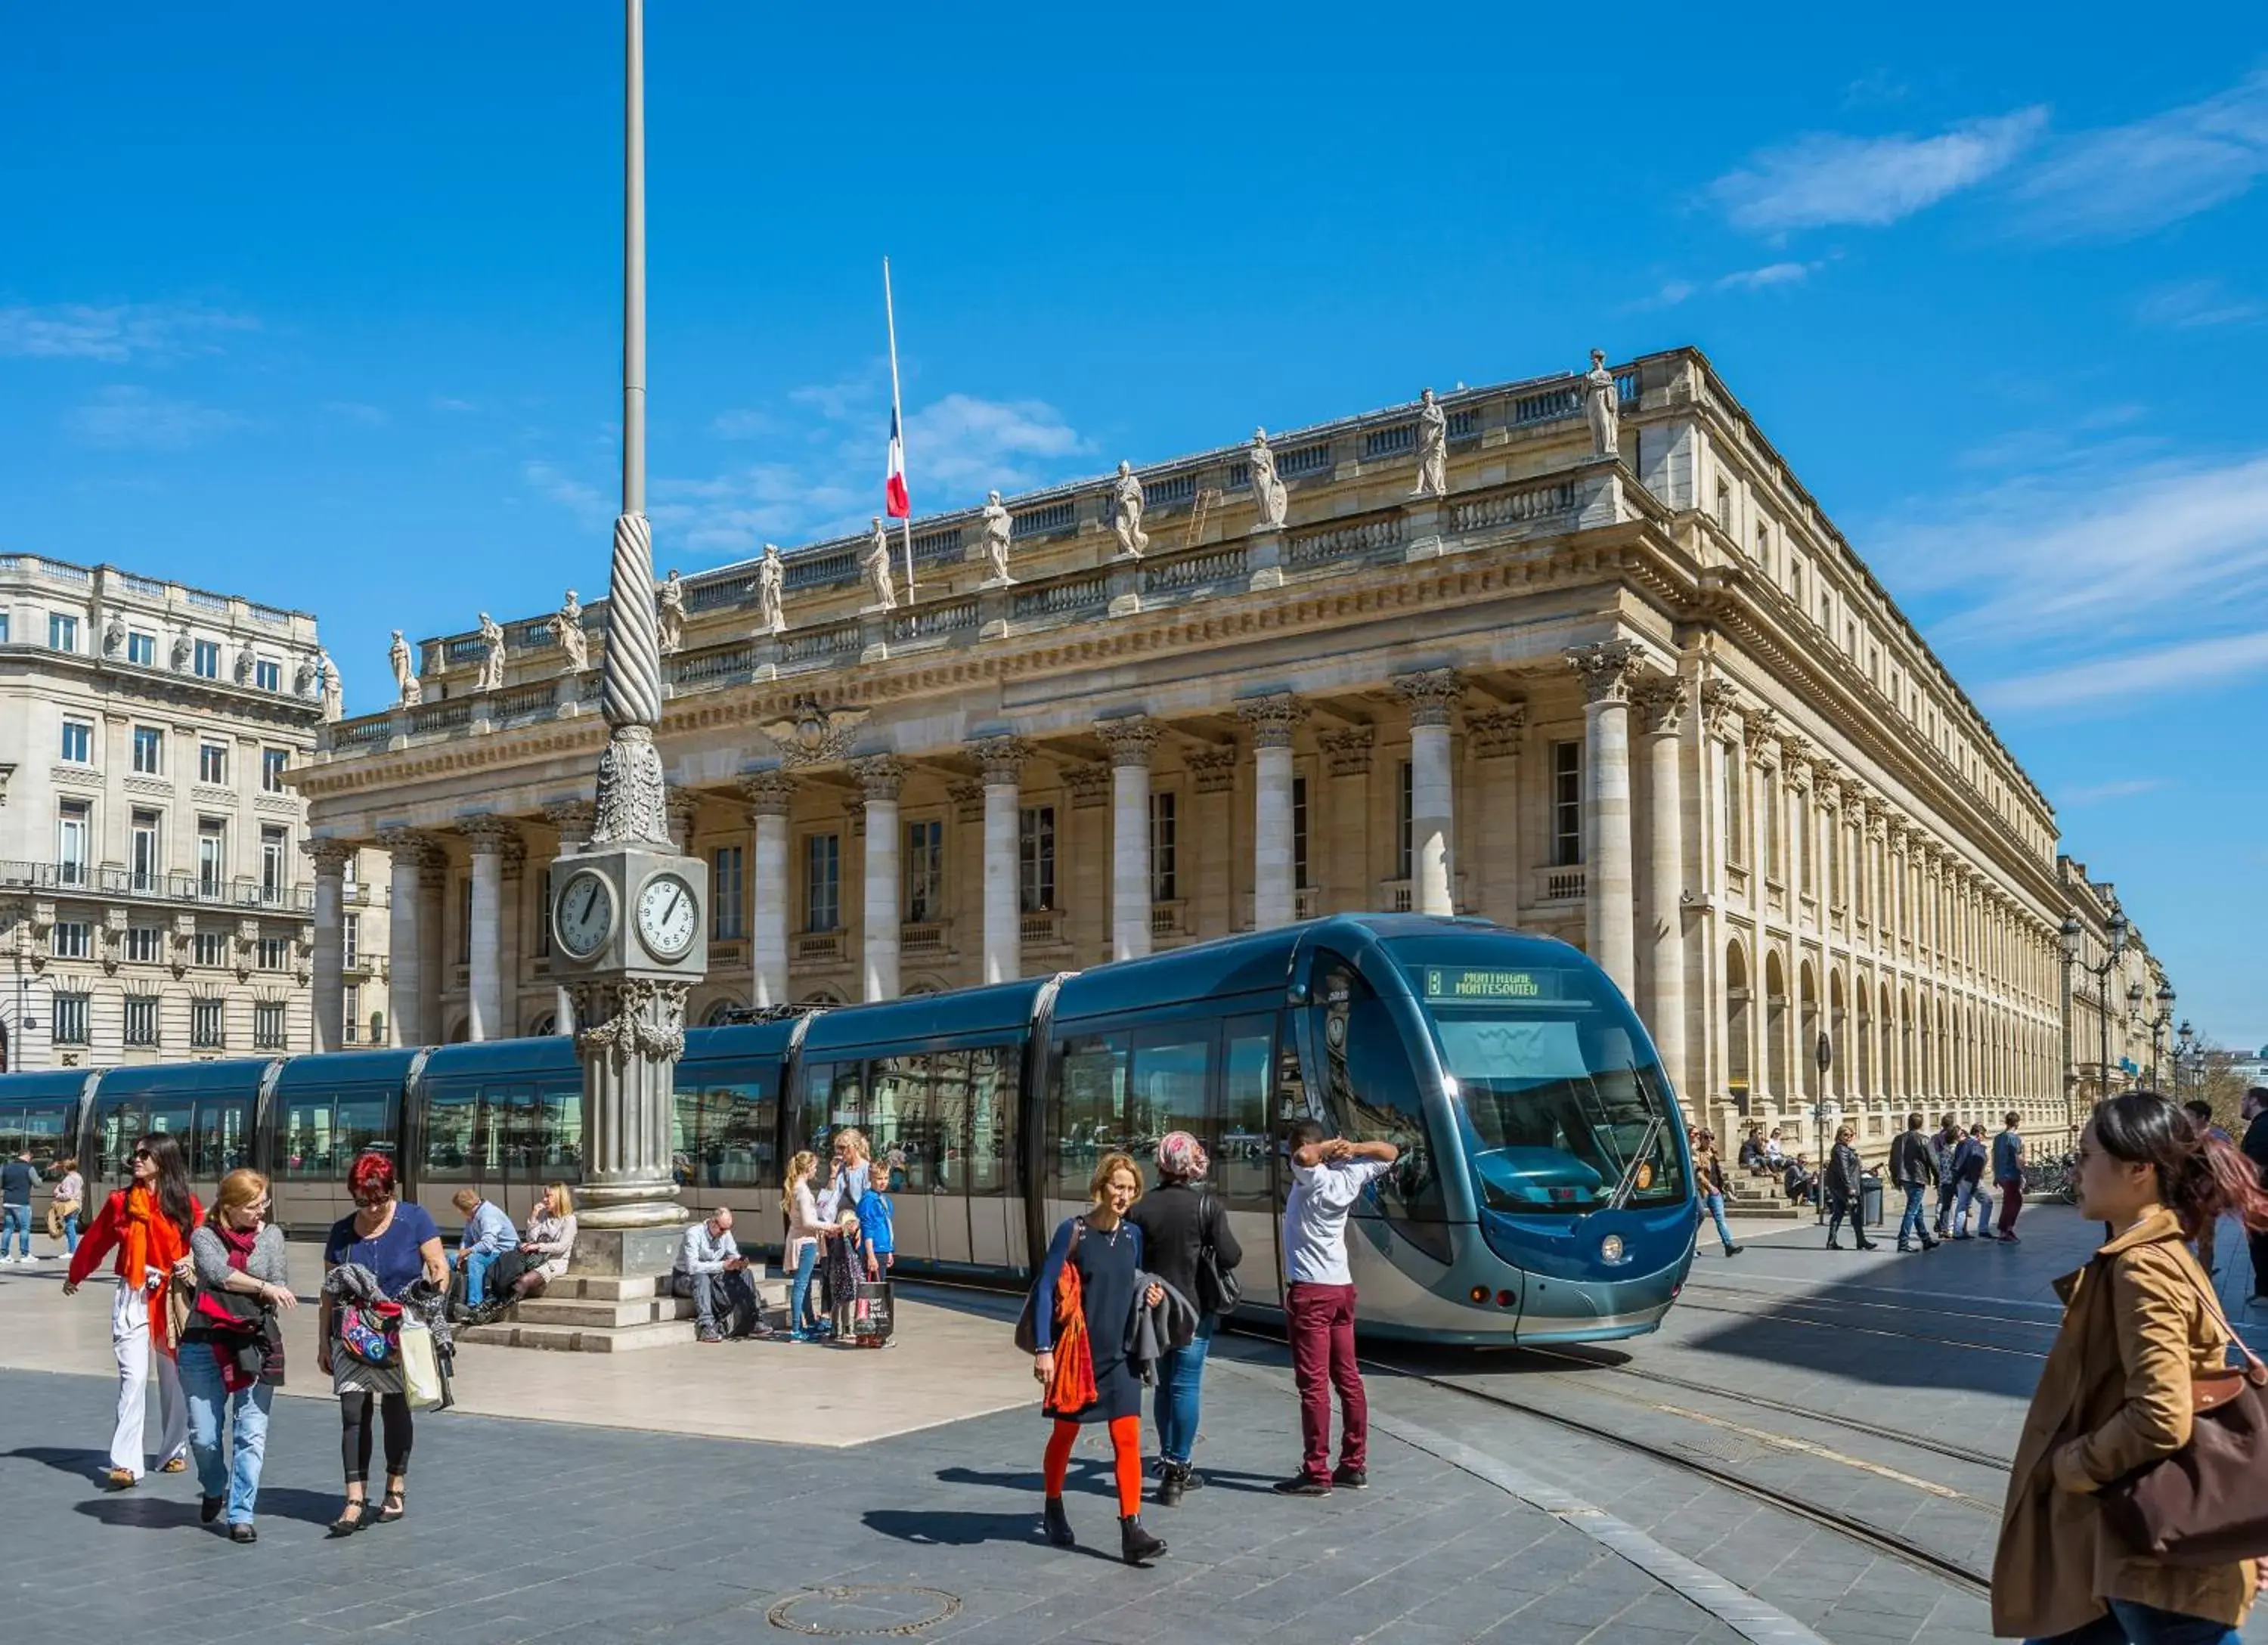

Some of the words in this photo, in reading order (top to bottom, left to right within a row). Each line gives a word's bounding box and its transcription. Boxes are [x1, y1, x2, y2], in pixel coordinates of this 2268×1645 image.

[644, 908, 651, 917] 9
[663, 937, 671, 946] 6
[674, 934, 680, 943] 5
[1428, 971, 1442, 995] B
[1455, 982, 1538, 996] MONTESQUIEU
